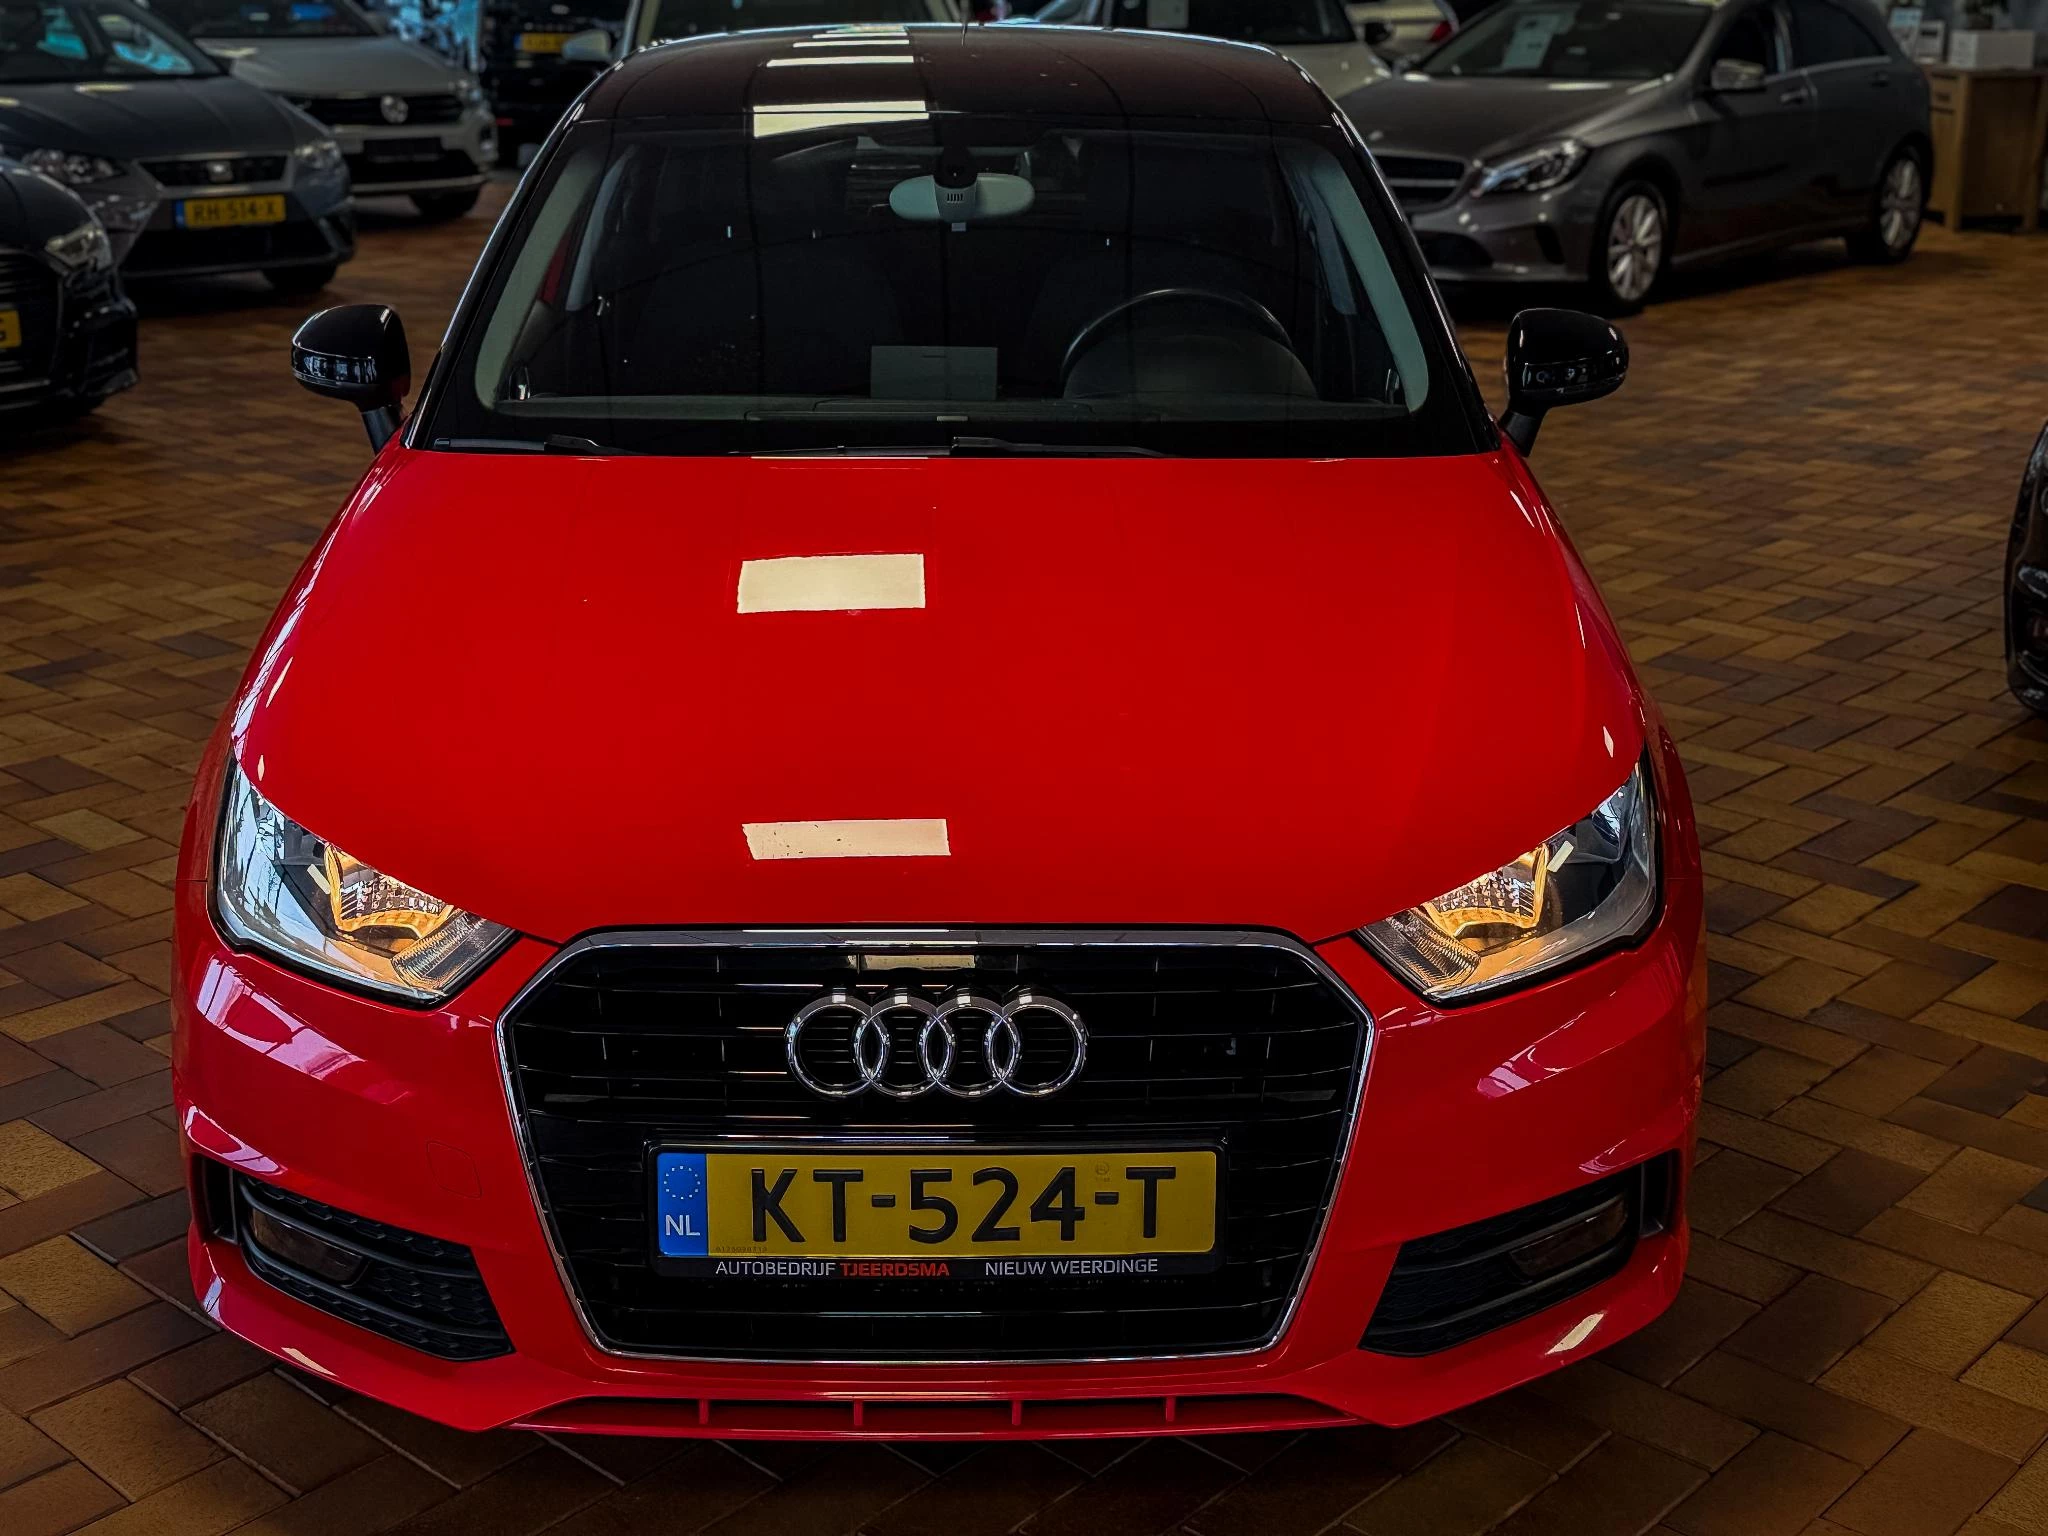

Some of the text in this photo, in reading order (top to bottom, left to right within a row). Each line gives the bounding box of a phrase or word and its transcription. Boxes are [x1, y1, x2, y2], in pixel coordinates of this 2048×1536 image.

[751, 1166, 1177, 1245] KT-524-T
[665, 1214, 701, 1236] NL
[715, 1258, 1159, 1278] AUTOBEDRIJF TJEERDSMA NIEUW WEERDINGE
